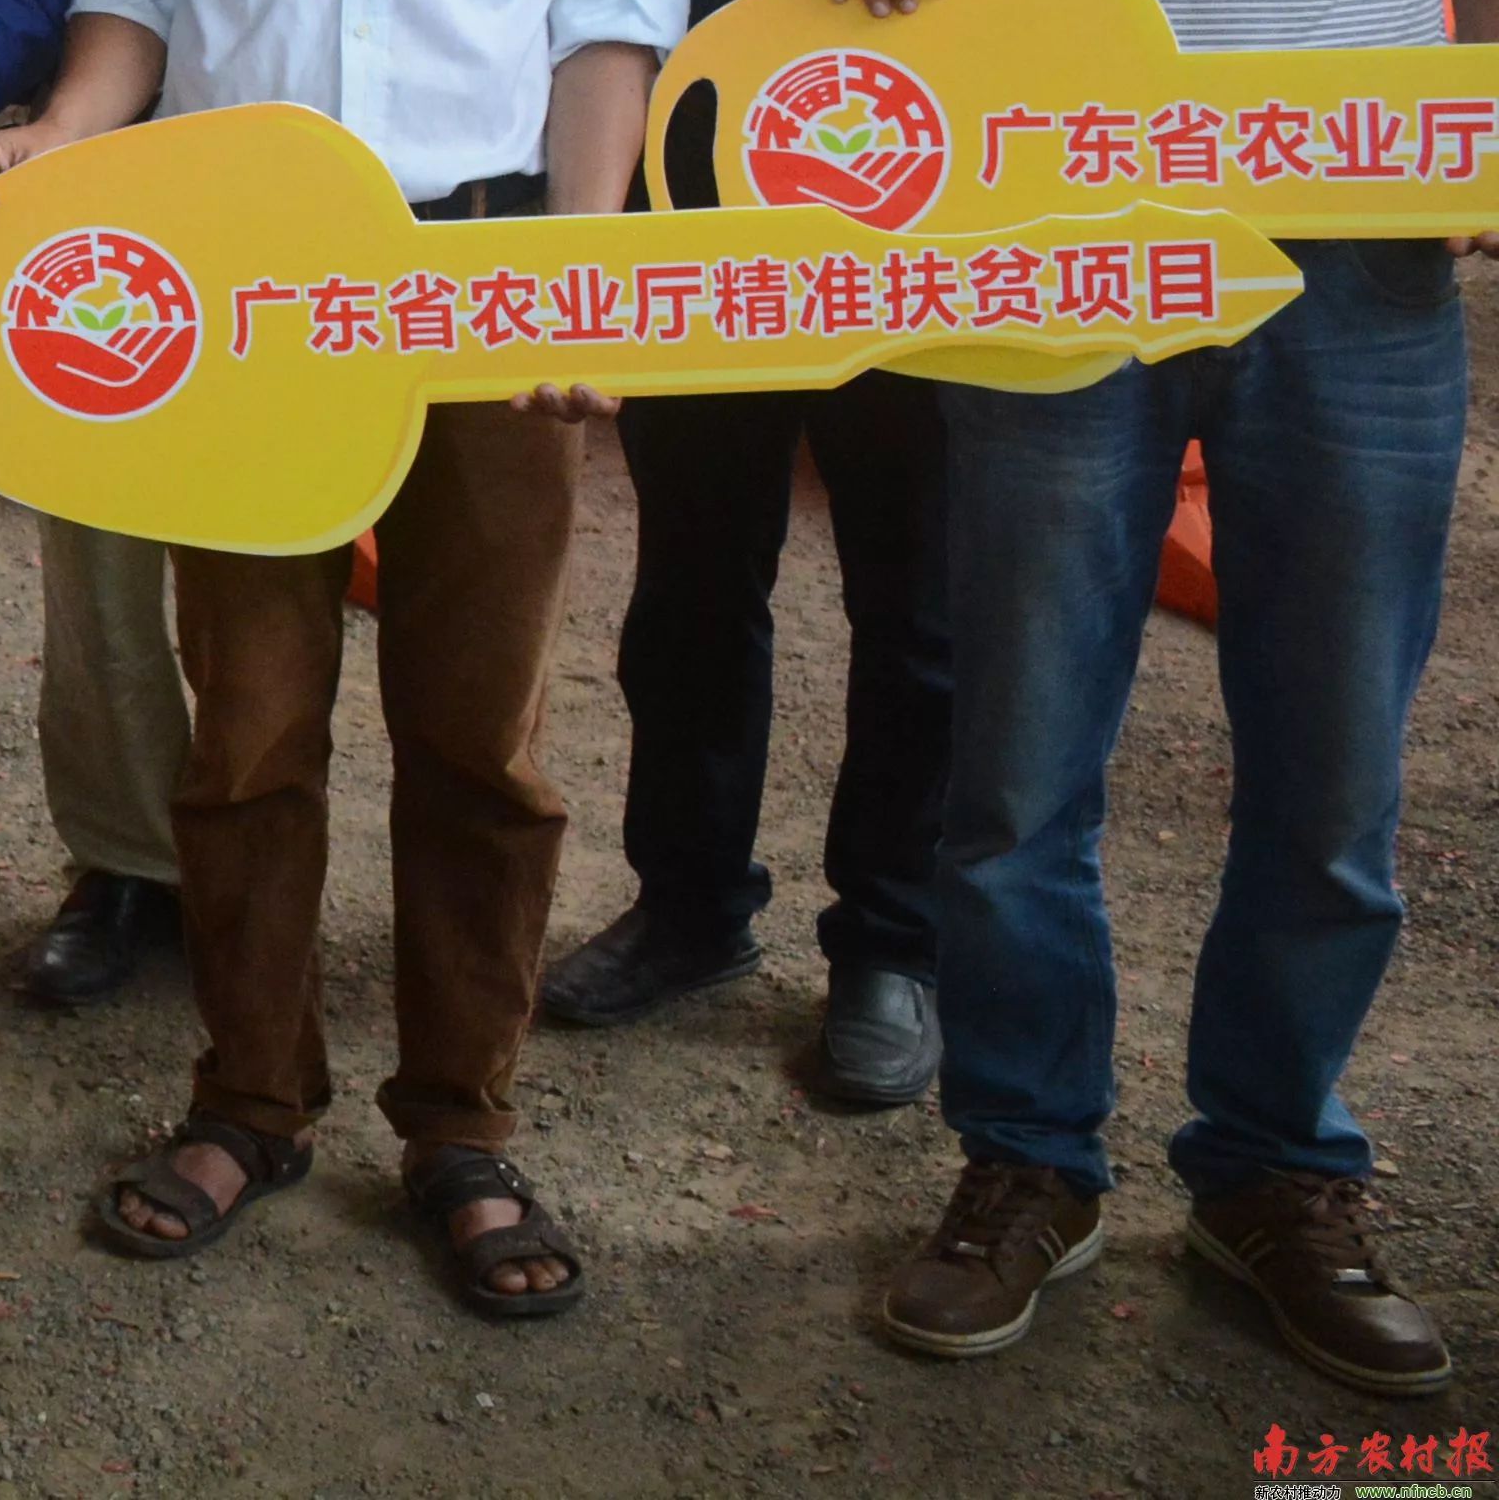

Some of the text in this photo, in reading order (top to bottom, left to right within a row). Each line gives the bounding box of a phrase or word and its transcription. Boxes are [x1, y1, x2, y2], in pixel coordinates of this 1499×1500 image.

[979, 99, 1496, 188] 广东省农业厅
[231, 237, 1220, 357] 广东省农业厅精准扶贫项目
